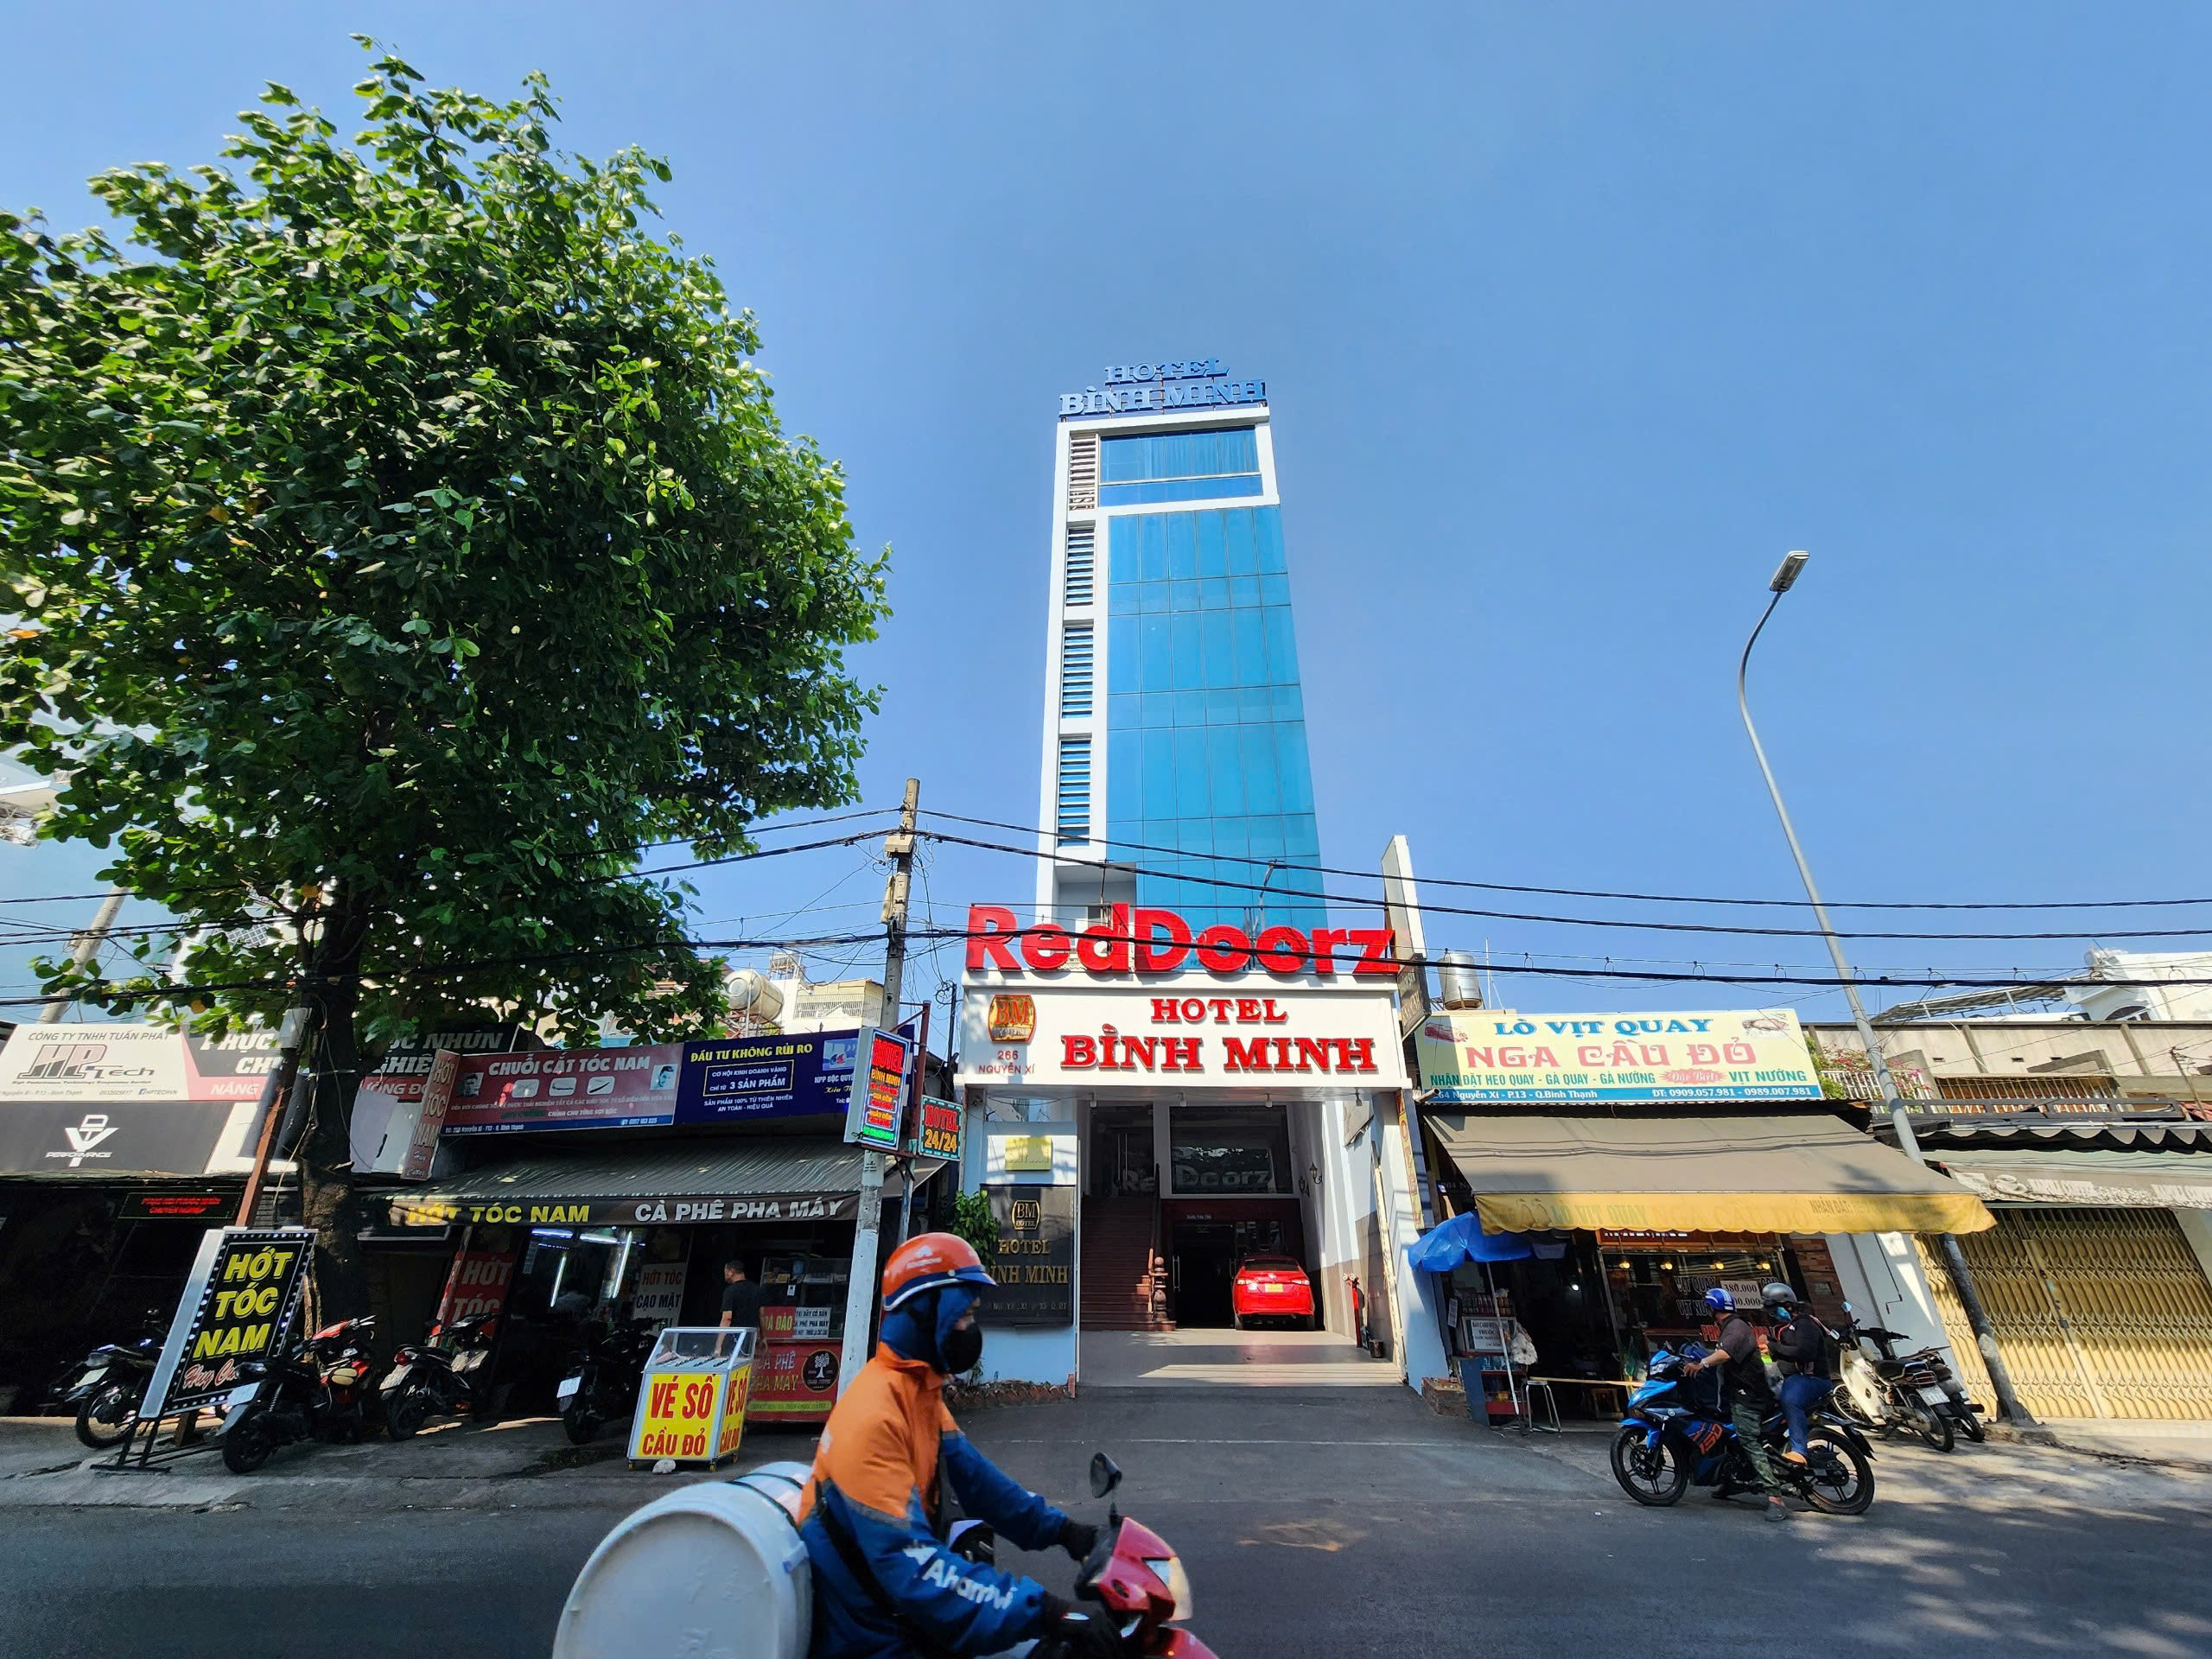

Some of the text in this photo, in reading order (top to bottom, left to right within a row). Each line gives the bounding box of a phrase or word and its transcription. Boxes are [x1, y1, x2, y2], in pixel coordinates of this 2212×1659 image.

[1104, 358, 1230, 386] HOTEL
[1058, 379, 1268, 417] BÌNH MINH
[965, 901, 1400, 975] RedDoorz
[995, 1001, 1031, 1025] BM
[1151, 998, 1288, 1023] HOTEL
[29, 1031, 60, 1041] CÔNG
[78, 1032, 105, 1040] TNHH
[1494, 1016, 1714, 1039] LÒ VỊT QUAY
[716, 1049, 732, 1060] TƯ
[732, 1046, 772, 1059] KHÔNG
[797, 1043, 813, 1054] RO
[872, 1038, 904, 1073] HOTEL
[997, 1051, 1019, 1060] 266
[1061, 1023, 1379, 1072] BÌNH MINH
[1467, 1037, 1758, 1068] NGA CẦU ĐỎ
[579, 1053, 610, 1072] TÓC
[613, 1056, 651, 1071] NAM
[748, 1067, 769, 1076] DOANH
[729, 1081, 735, 1090] 3
[1485, 1074, 1506, 1086] HEO
[1509, 1073, 1535, 1086] QUAY
[1545, 1071, 1560, 1085] GÀ
[1563, 1073, 1589, 1085] QUAY
[1599, 1071, 1616, 1084] GÀ
[1728, 1071, 1750, 1085] VỊT
[1452, 1090, 1486, 1102] Nguyễn
[1535, 1090, 1566, 1100] Q.Bình
[1567, 1090, 1598, 1101] Thạnh
[1744, 1087, 1812, 1096] 0989.007.981
[925, 1105, 958, 1133] HOTEL
[413, 1123, 441, 1148] NAM
[925, 1128, 957, 1154] 24/24
[473, 1202, 522, 1224] TÓC
[530, 1205, 589, 1223] NAM
[635, 1198, 668, 1221] CÀ
[675, 1198, 726, 1221] PHÊ
[731, 1200, 782, 1219] PHA
[789, 1197, 846, 1217] MÁY
[1016, 1203, 1036, 1218] BM
[997, 1239, 1051, 1254] HOTEL
[223, 1246, 294, 1281] HỚT
[461, 1258, 512, 1286] HỚT
[990, 1263, 1069, 1284] ÌNH MINH
[664, 1268, 683, 1286] TÓC
[214, 1282, 278, 1319] TÓC
[636, 1291, 681, 1312] CẠO MẶT
[192, 1323, 271, 1361] NAM
[774, 1350, 796, 1370] PHÊ
[773, 1370, 799, 1392] MÁY
[650, 1373, 717, 1420] VÉ SỐ
[642, 1426, 706, 1456] CẦU ĐỎ
